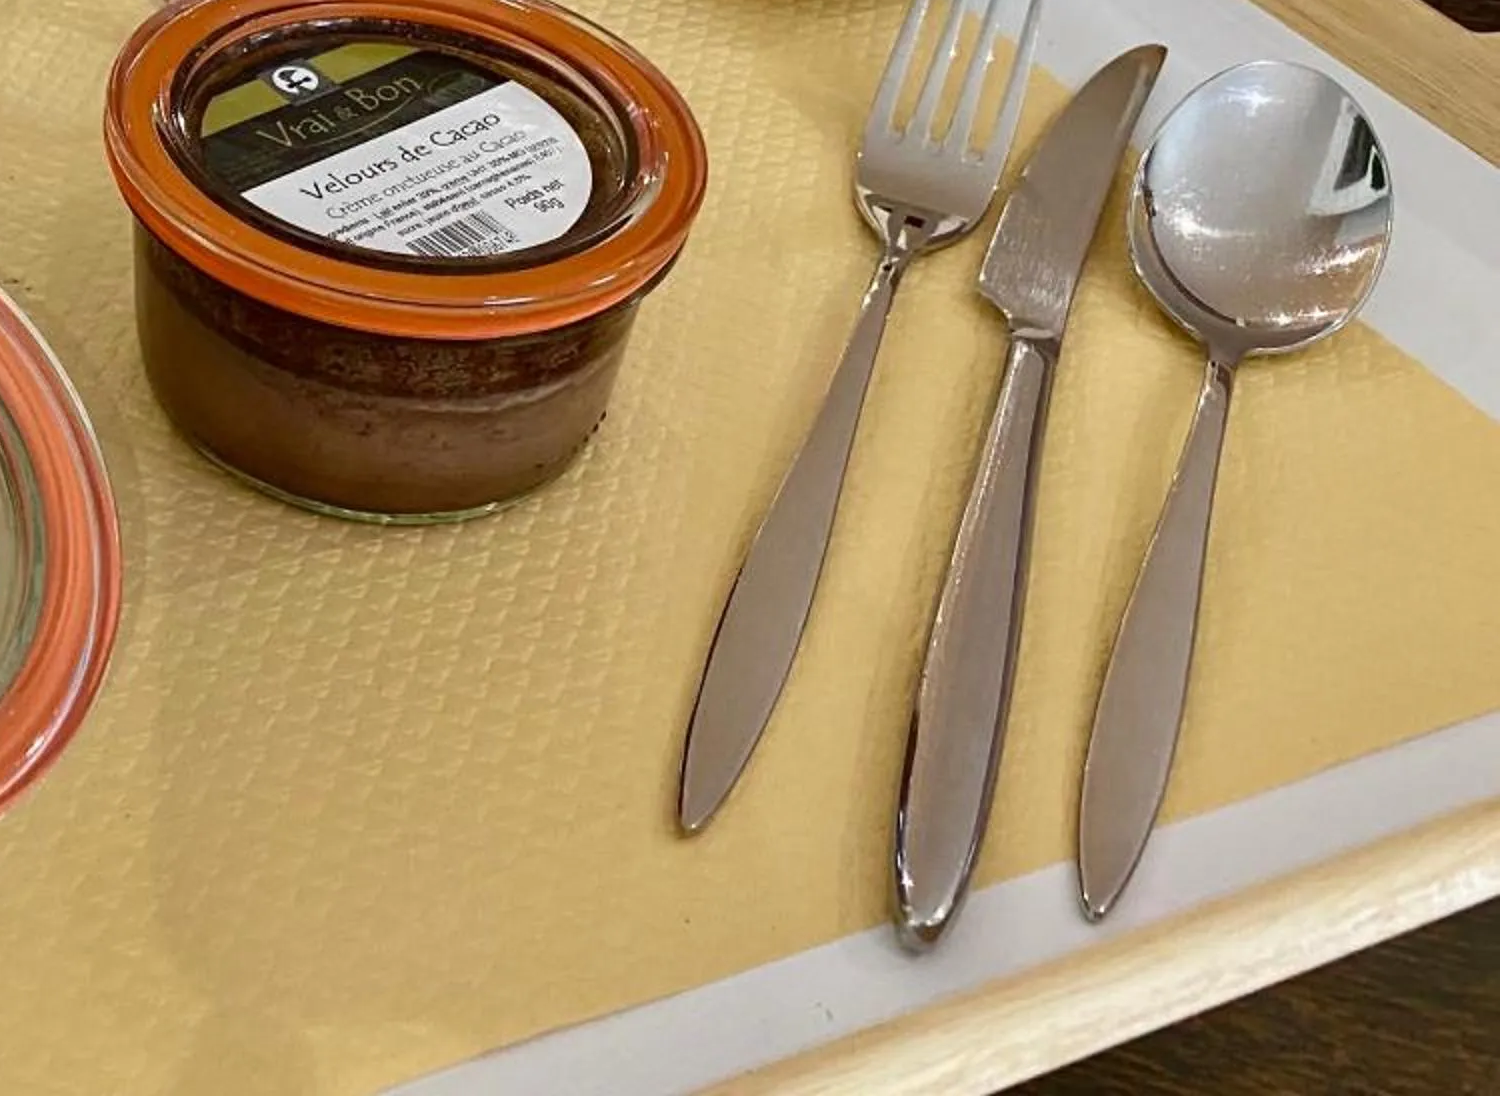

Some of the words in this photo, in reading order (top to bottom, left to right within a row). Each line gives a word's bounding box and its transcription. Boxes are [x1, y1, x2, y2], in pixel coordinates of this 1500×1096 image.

[255, 109, 336, 148] Vrai
[344, 75, 422, 111] Bon
[299, 156, 398, 201] Velours
[399, 144, 432, 164] de
[429, 113, 501, 147] Cacao
[326, 190, 384, 221] Crème
[382, 159, 461, 199] onctueuse
[462, 149, 480, 164] au
[479, 130, 527, 154] Cacao
